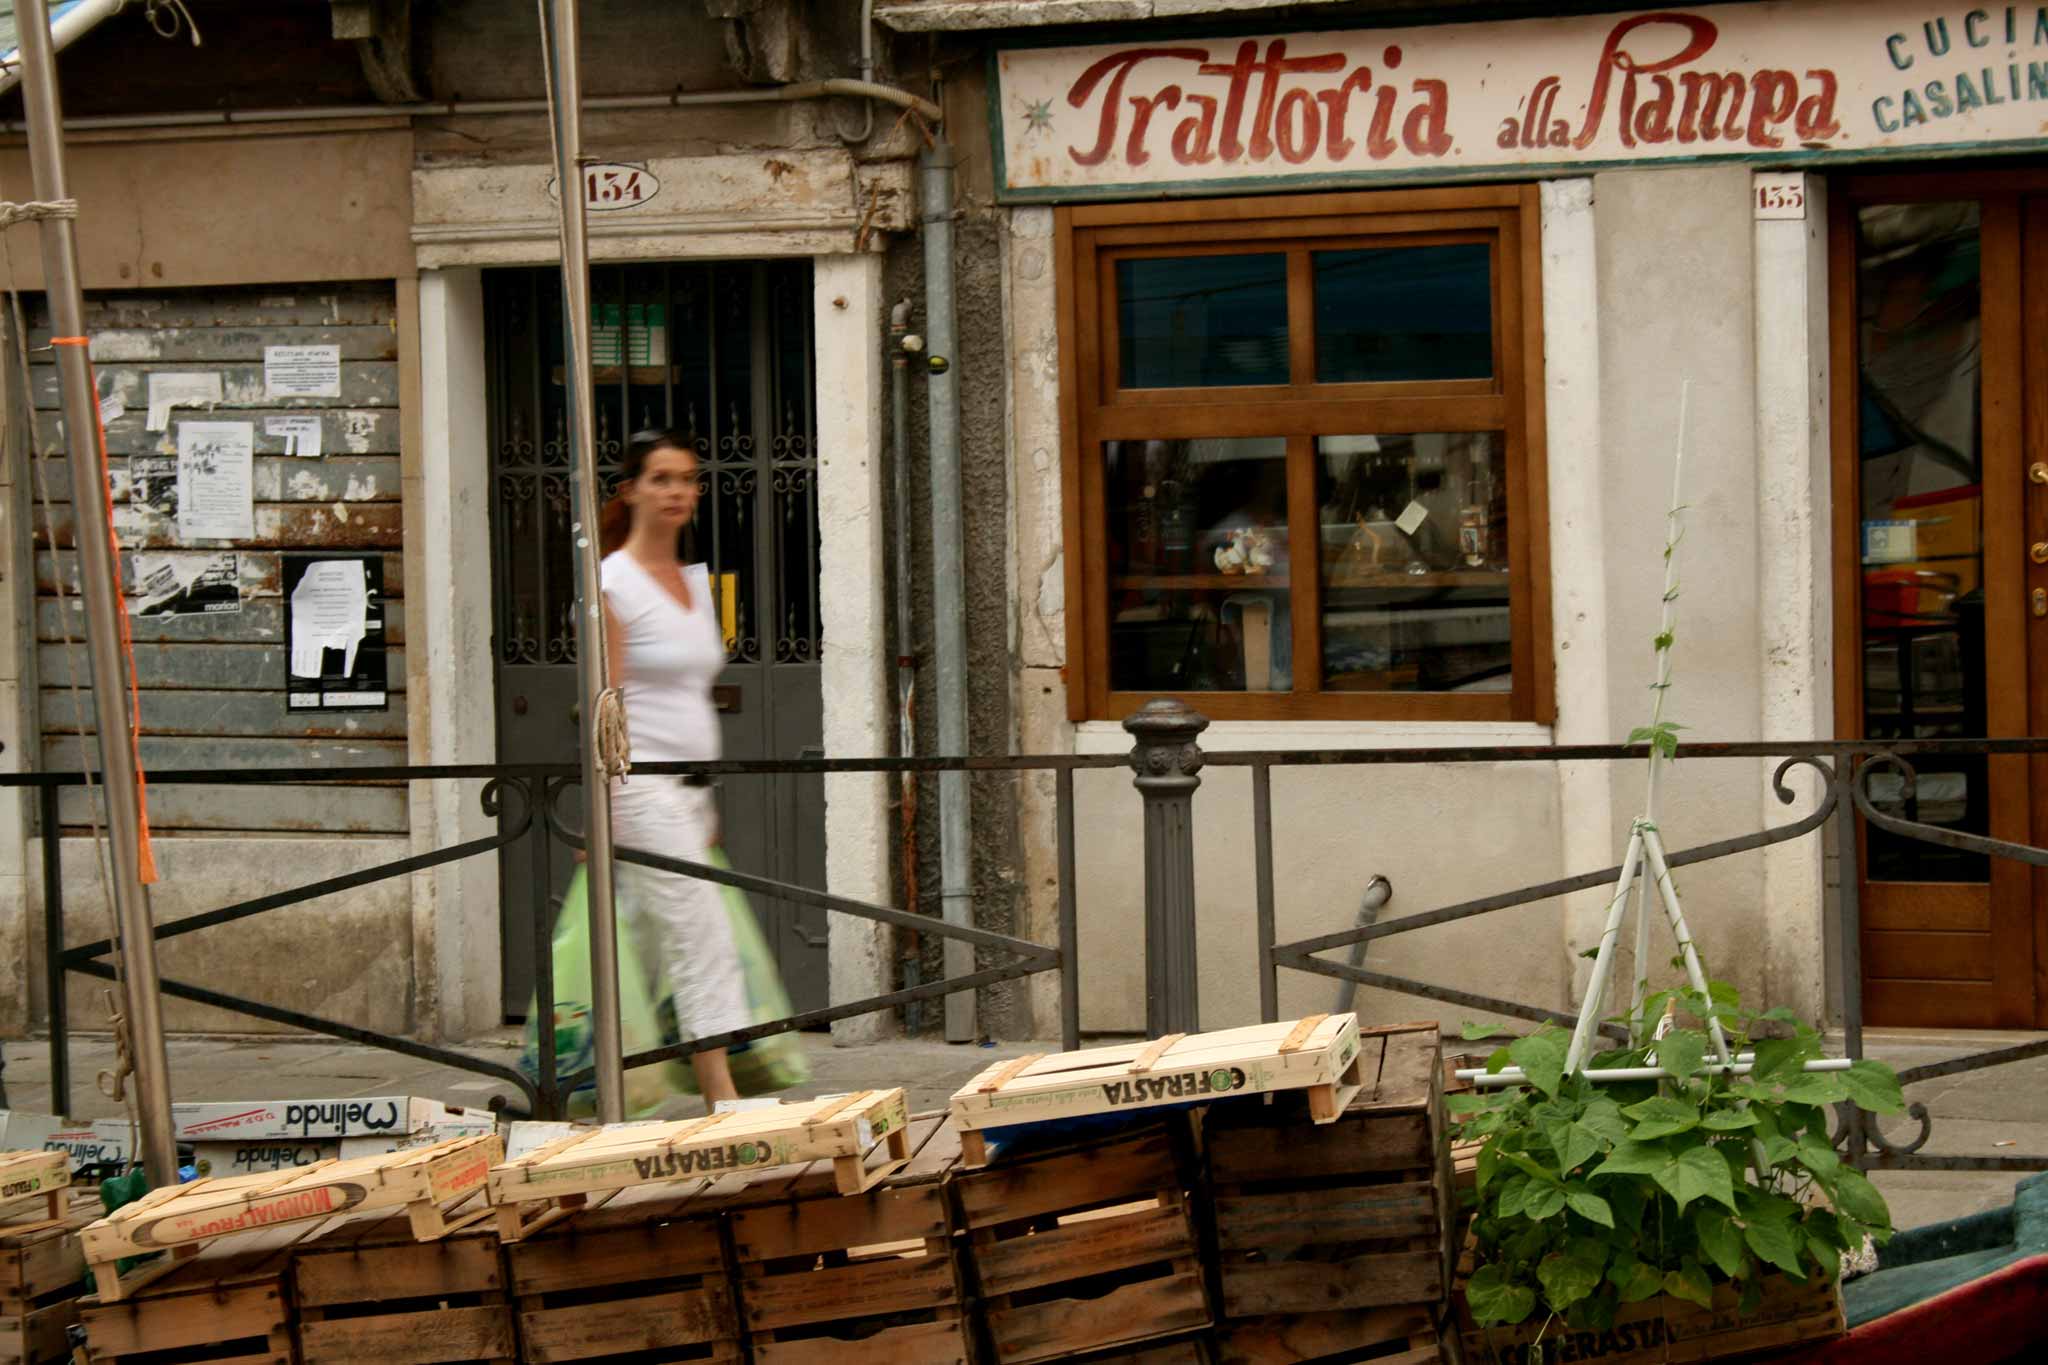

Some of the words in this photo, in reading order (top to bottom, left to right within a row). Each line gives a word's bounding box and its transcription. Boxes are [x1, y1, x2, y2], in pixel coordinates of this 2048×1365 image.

[1067, 39, 1453, 166] Trattoria
[1496, 75, 1571, 148] alla
[1571, 12, 1841, 150] Rampa
[1103, 1067, 1246, 1105] COFERASTA
[286, 1101, 398, 1136] Melinda
[236, 1148, 321, 1171] Melinda
[633, 1140, 772, 1180] COFERASTA
